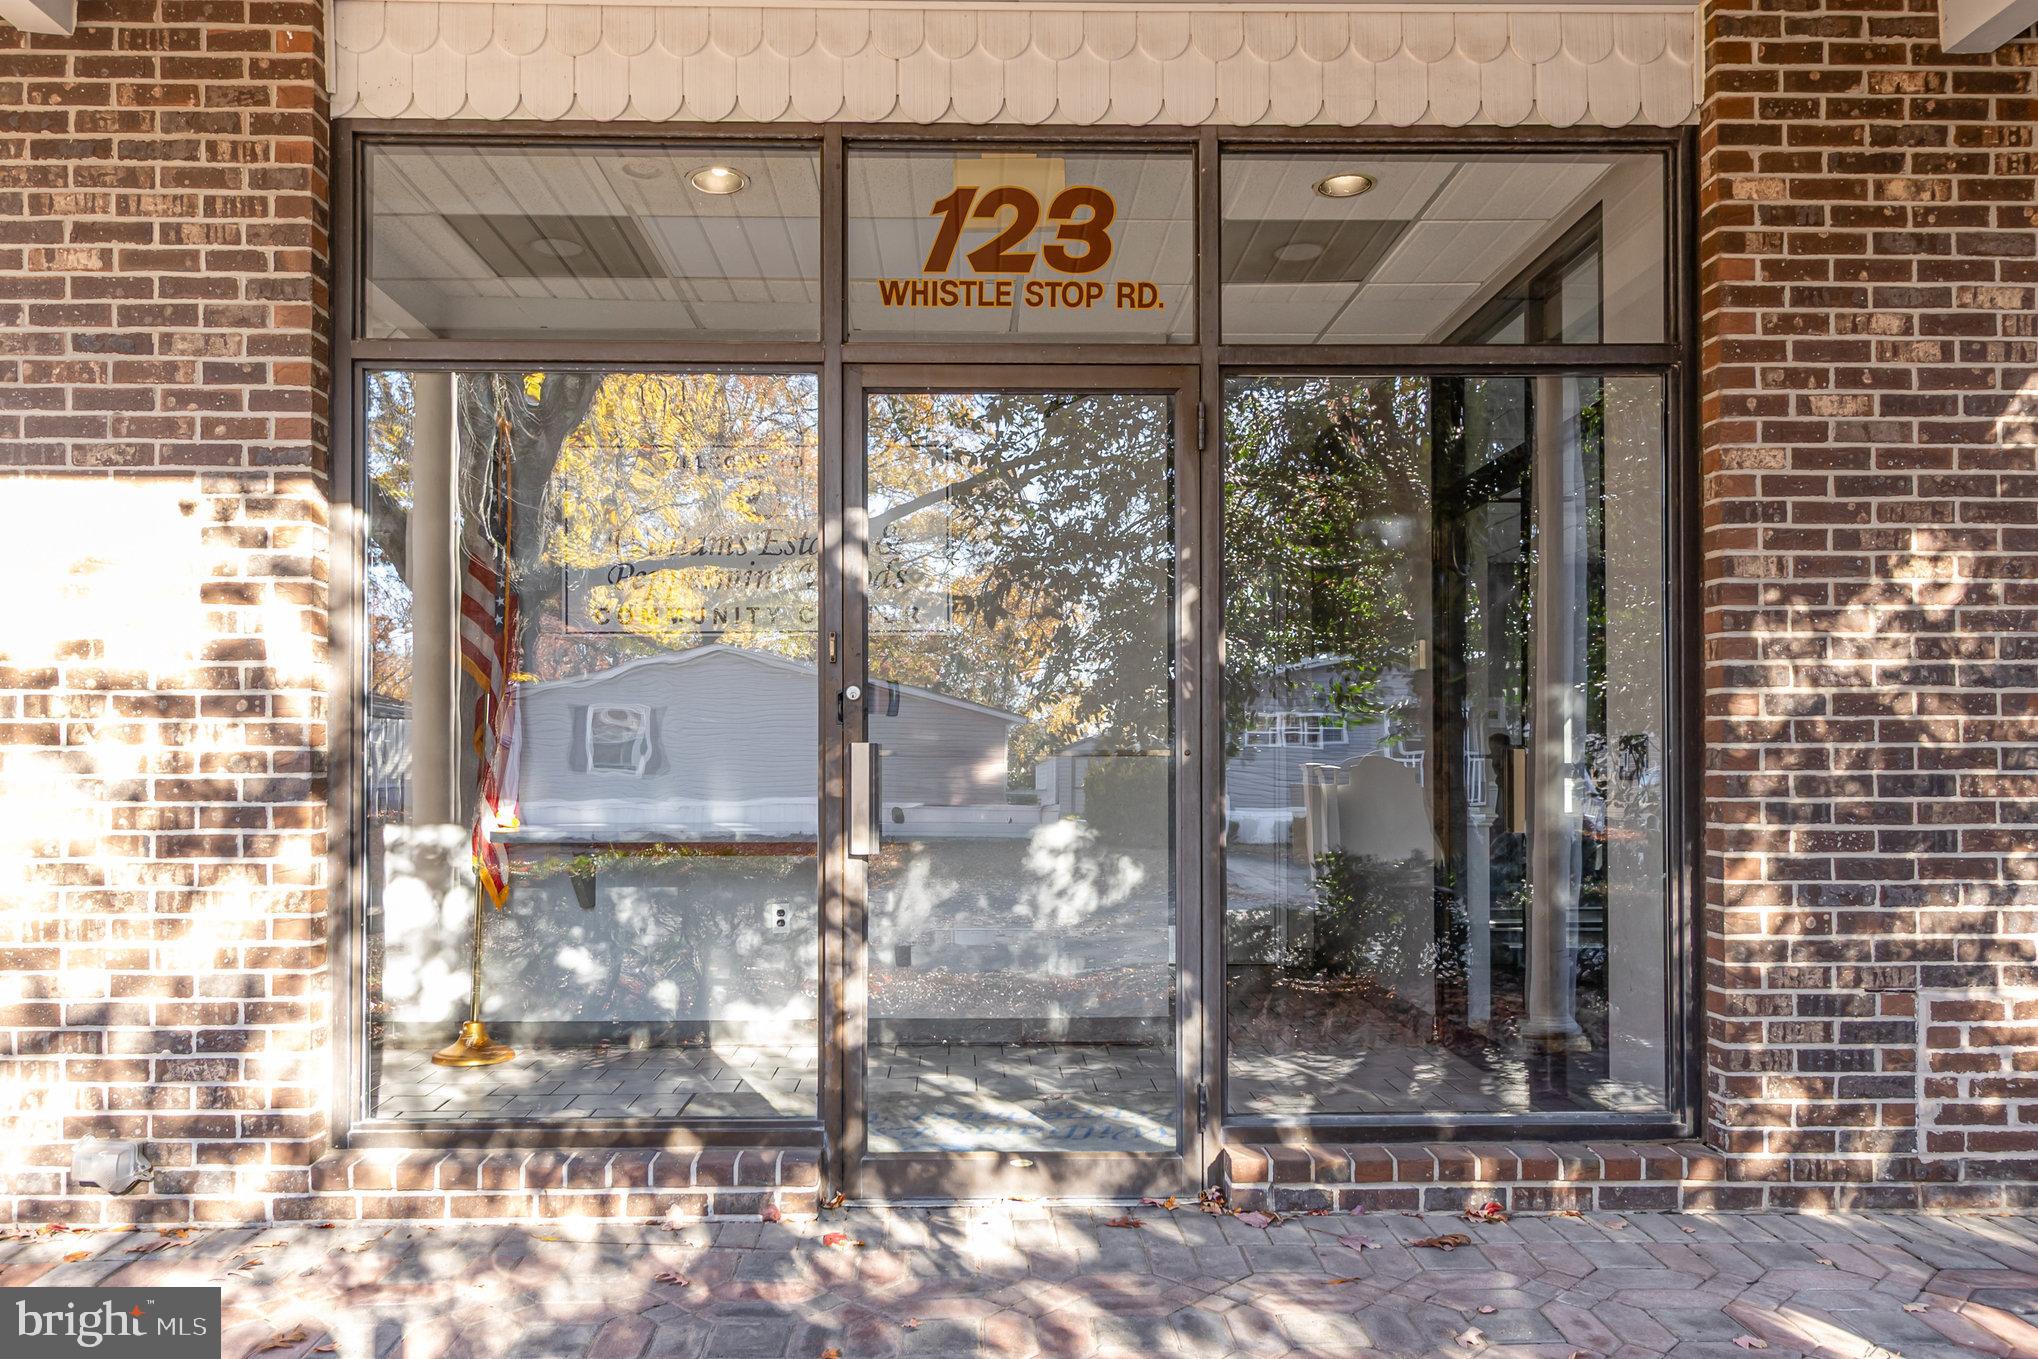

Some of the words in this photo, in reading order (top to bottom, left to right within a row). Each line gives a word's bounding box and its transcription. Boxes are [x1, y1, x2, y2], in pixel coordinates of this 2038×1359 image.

[922, 185, 1117, 274] 123
[878, 280, 1013, 308] WHISTLE
[1024, 281, 1104, 308] STOP
[1116, 282, 1164, 309] RD.
